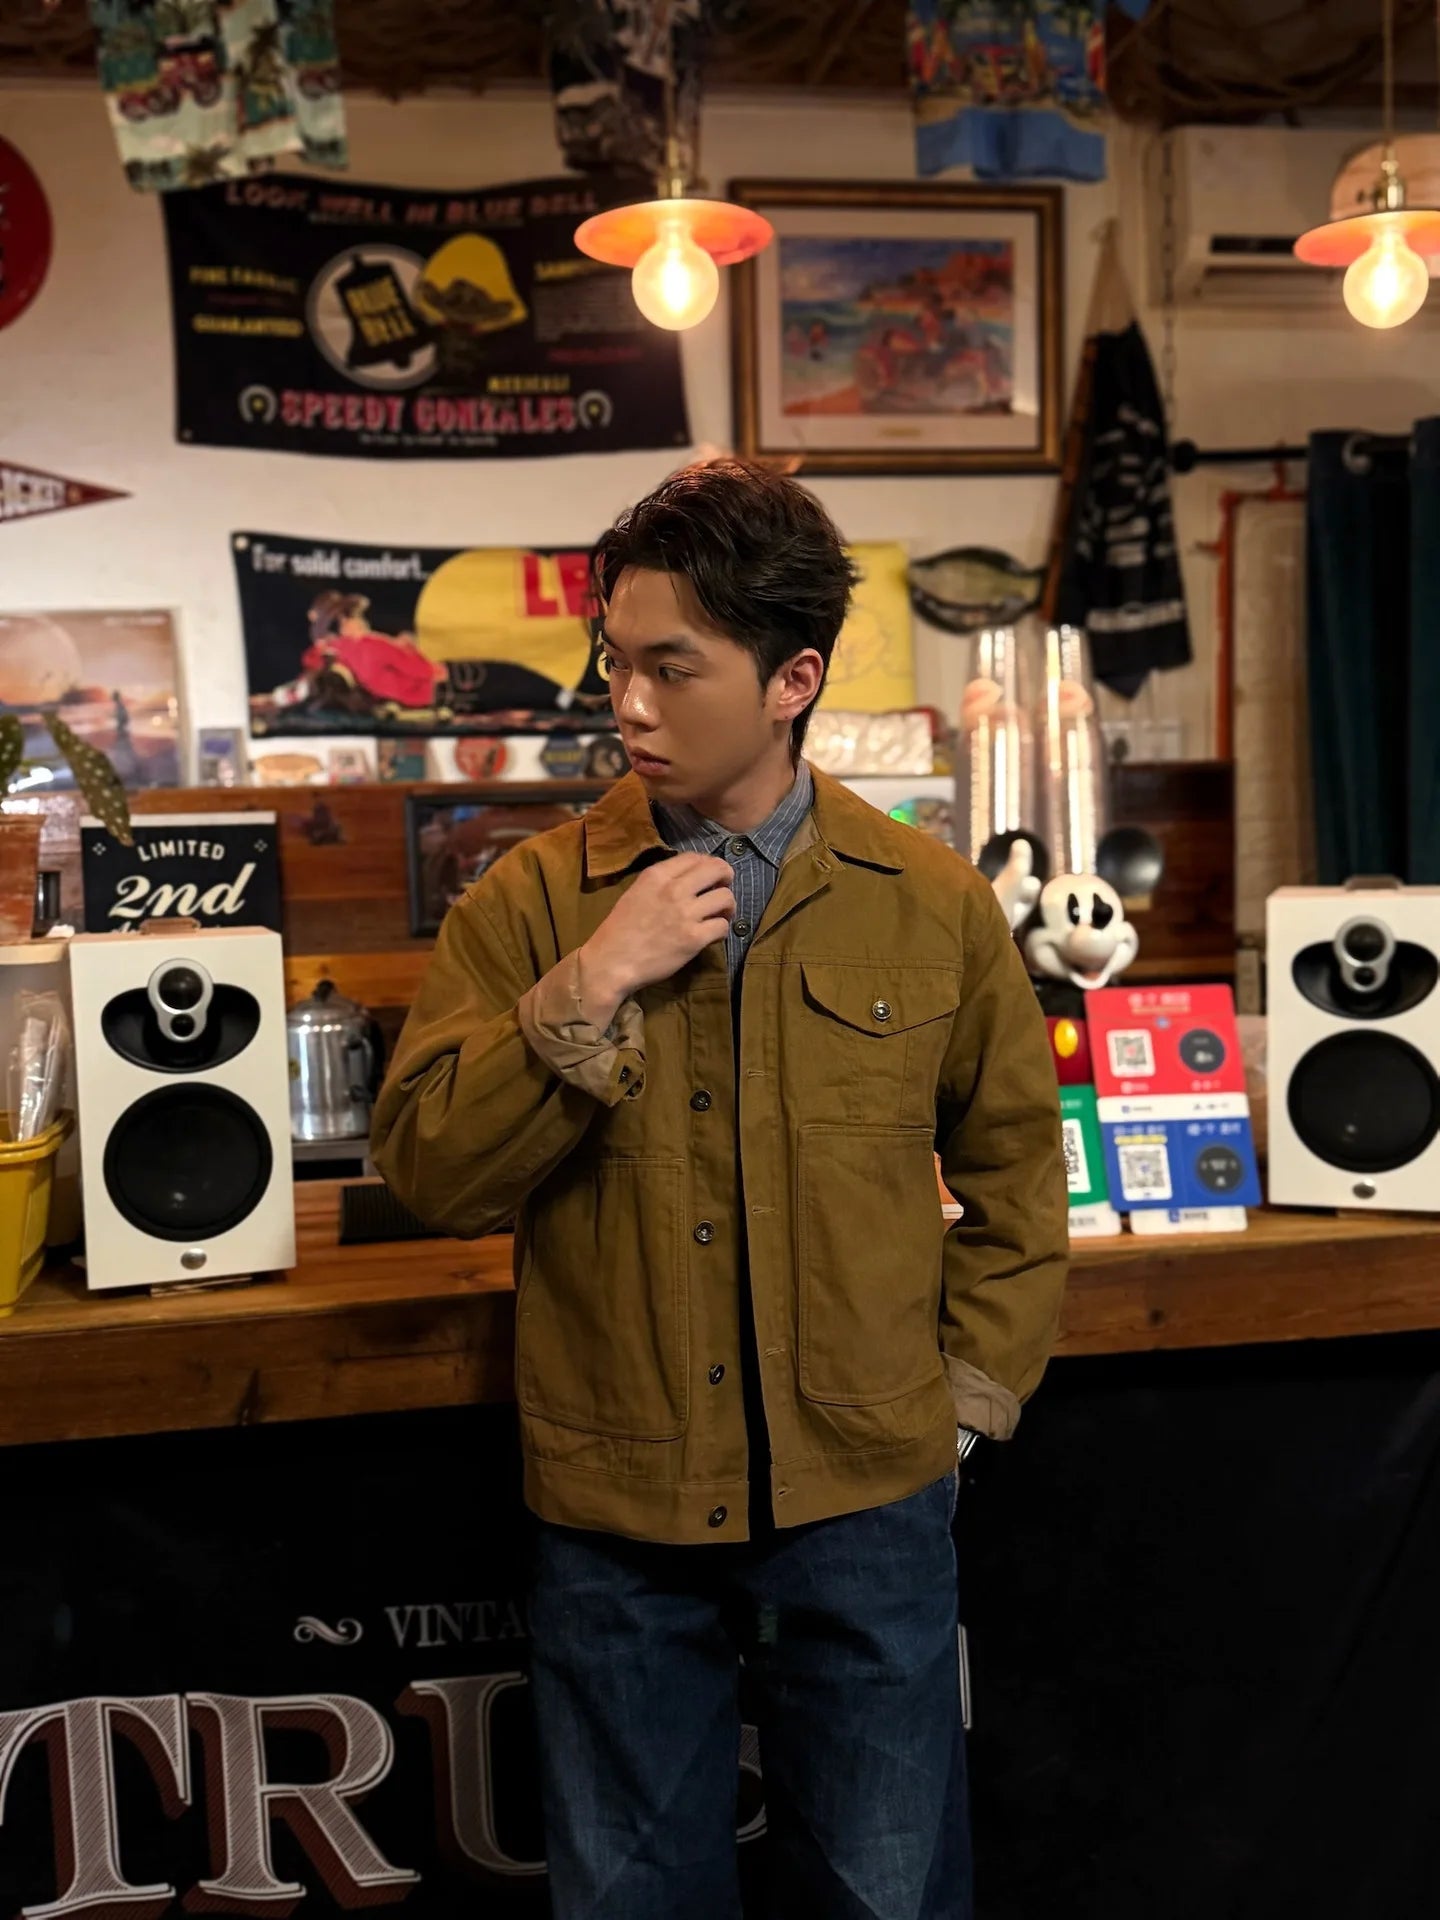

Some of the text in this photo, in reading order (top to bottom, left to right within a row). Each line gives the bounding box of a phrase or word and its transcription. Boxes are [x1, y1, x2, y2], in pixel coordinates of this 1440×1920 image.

[280, 390, 578, 435] SPEEDY GONZALES
[252, 543, 286, 572] For
[290, 548, 341, 578] solid
[137, 839, 226, 862] LIMITED
[107, 862, 257, 919] 2nd
[383, 1599, 532, 1649] VINTA
